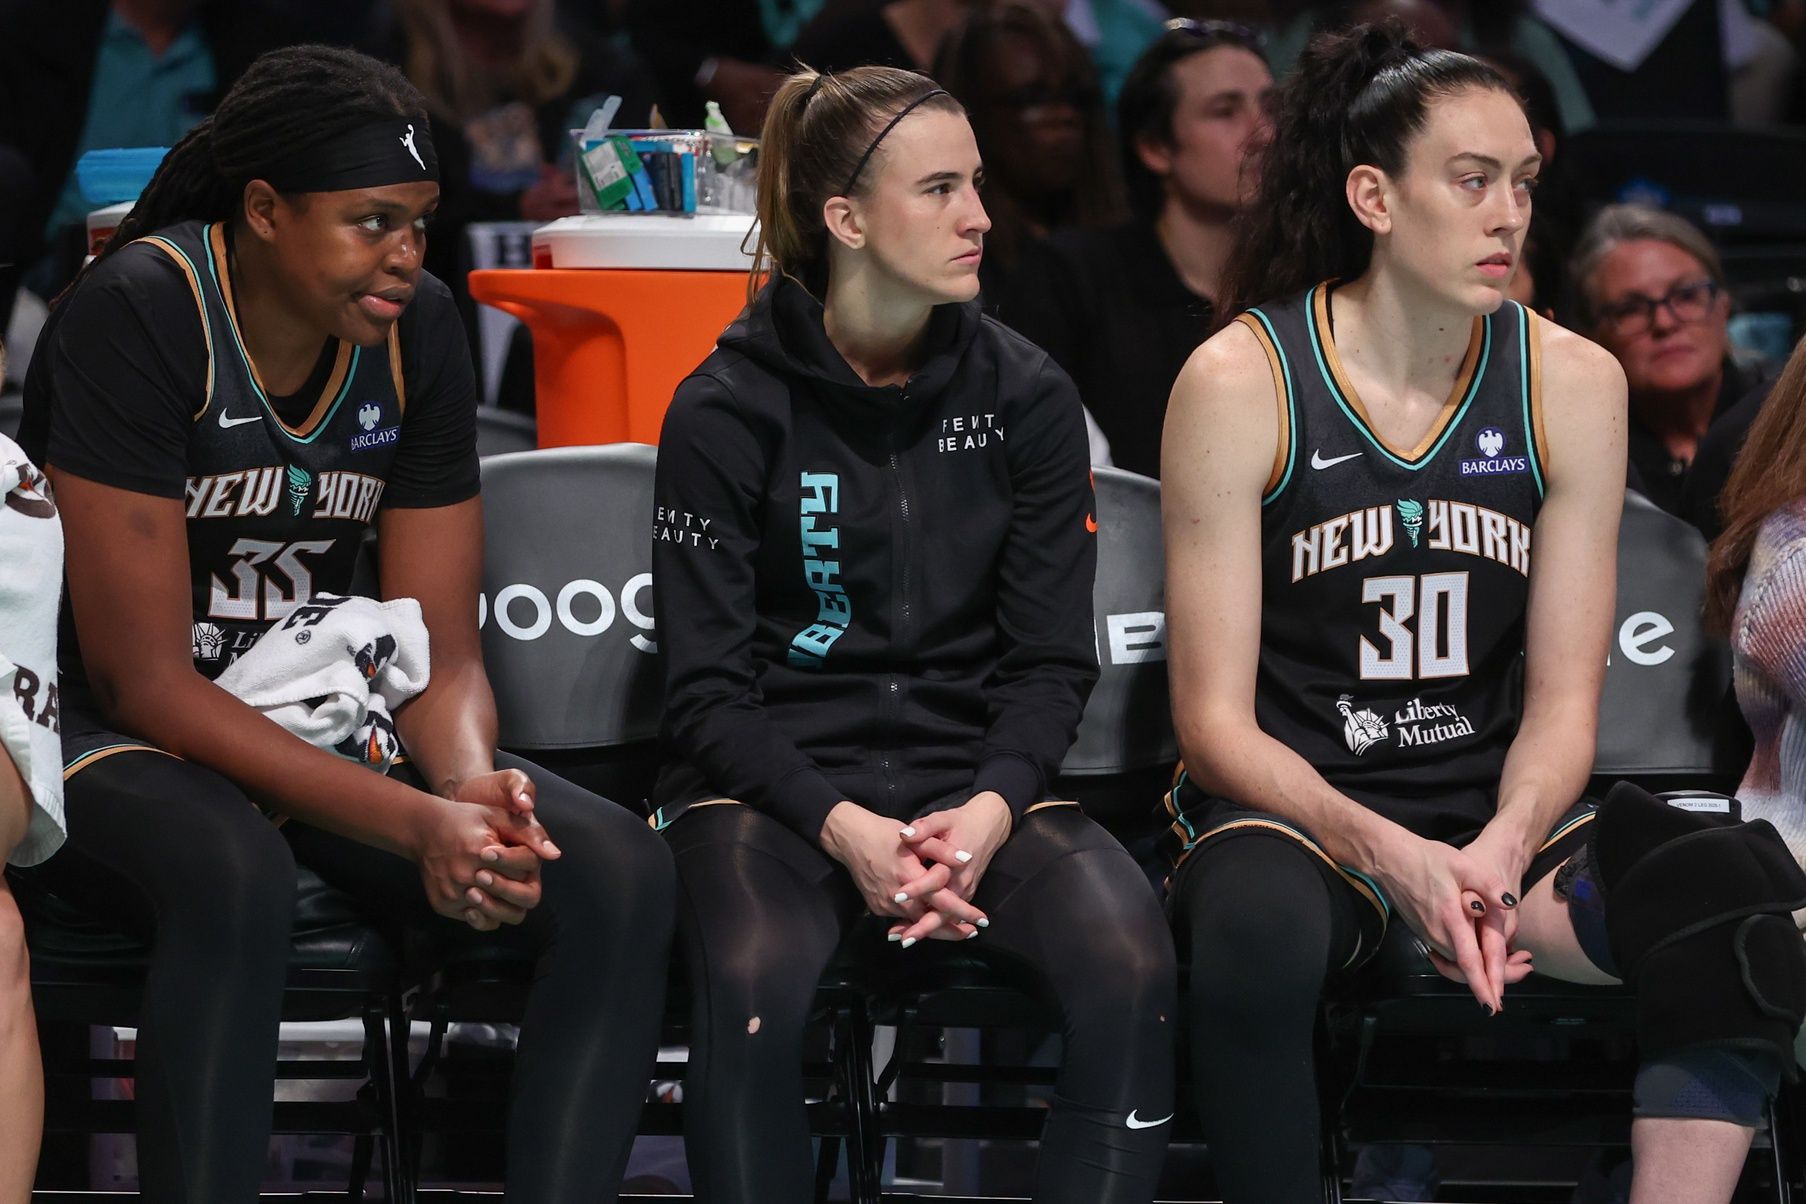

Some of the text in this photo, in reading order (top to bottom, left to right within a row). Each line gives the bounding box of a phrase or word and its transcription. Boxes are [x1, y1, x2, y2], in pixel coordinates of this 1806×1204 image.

[351, 428, 398, 451] BARCLAYS
[1461, 458, 1526, 475] BARCLAYS
[185, 466, 284, 519] NEW
[657, 506, 711, 531] ENTY
[653, 525, 719, 550] EAUTY
[1291, 500, 1531, 583] NEW YORK
[207, 538, 337, 621] 35
[479, 572, 658, 654] oog
[1359, 571, 1470, 681] 30
[1394, 698, 1460, 724] Liberty
[1397, 716, 1476, 748] Mutual
